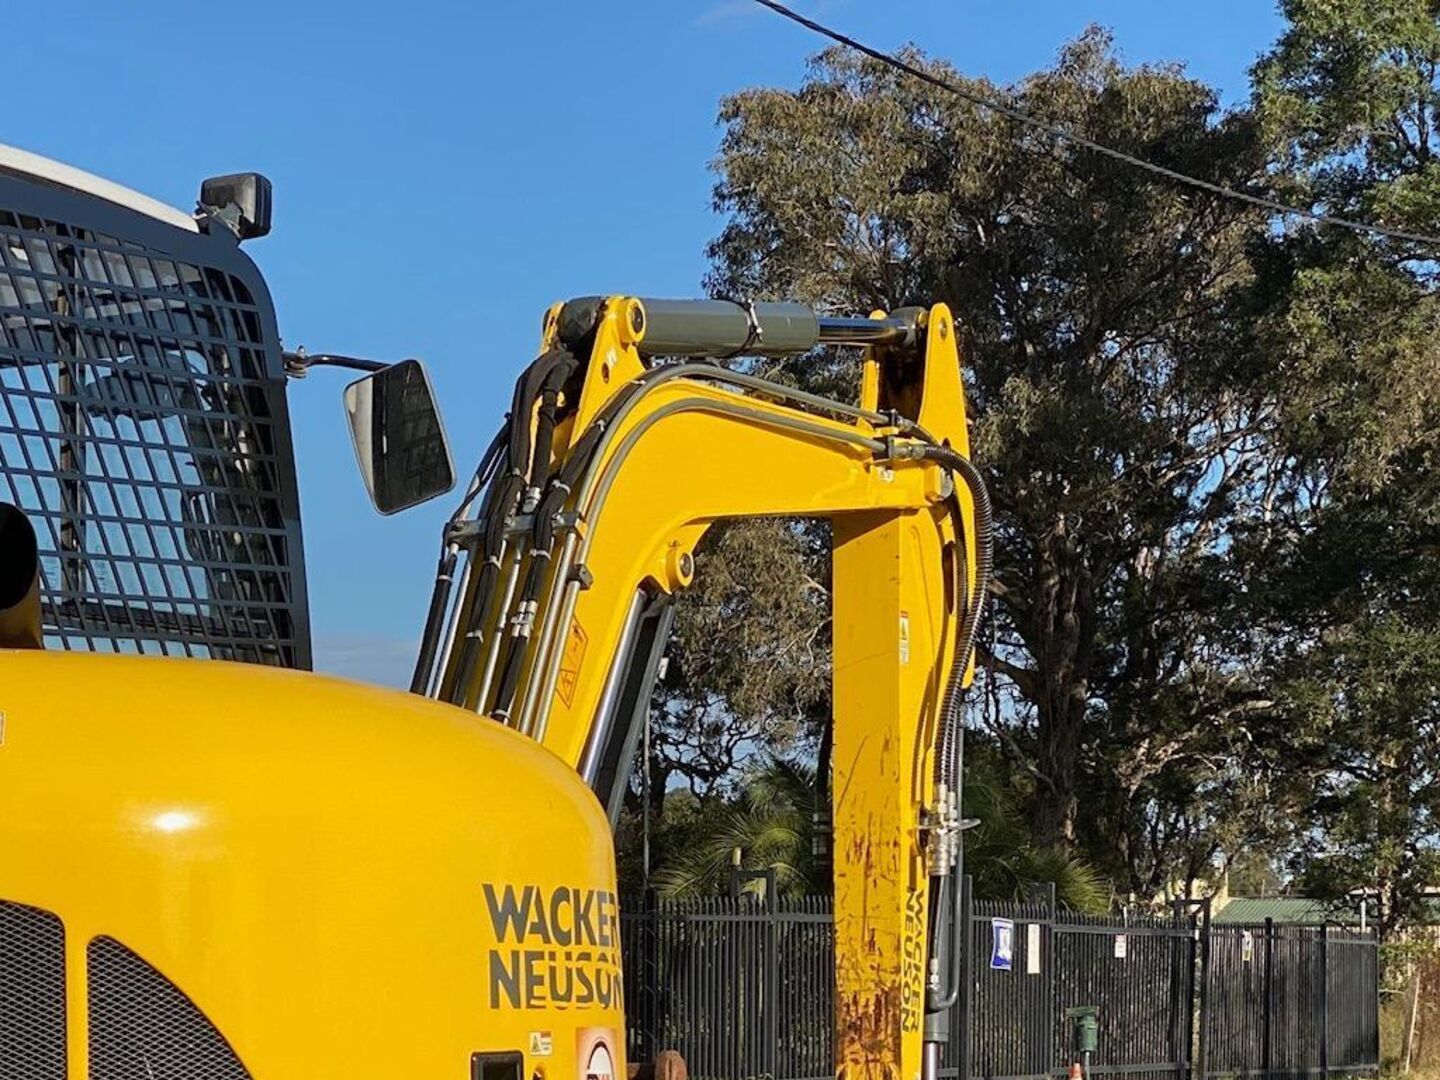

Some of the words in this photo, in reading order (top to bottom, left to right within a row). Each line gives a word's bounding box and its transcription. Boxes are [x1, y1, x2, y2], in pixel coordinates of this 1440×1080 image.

[489, 949, 622, 1011] NEUSON
[902, 886, 915, 1033] NEUSON
[910, 889, 924, 1033] WACKER
